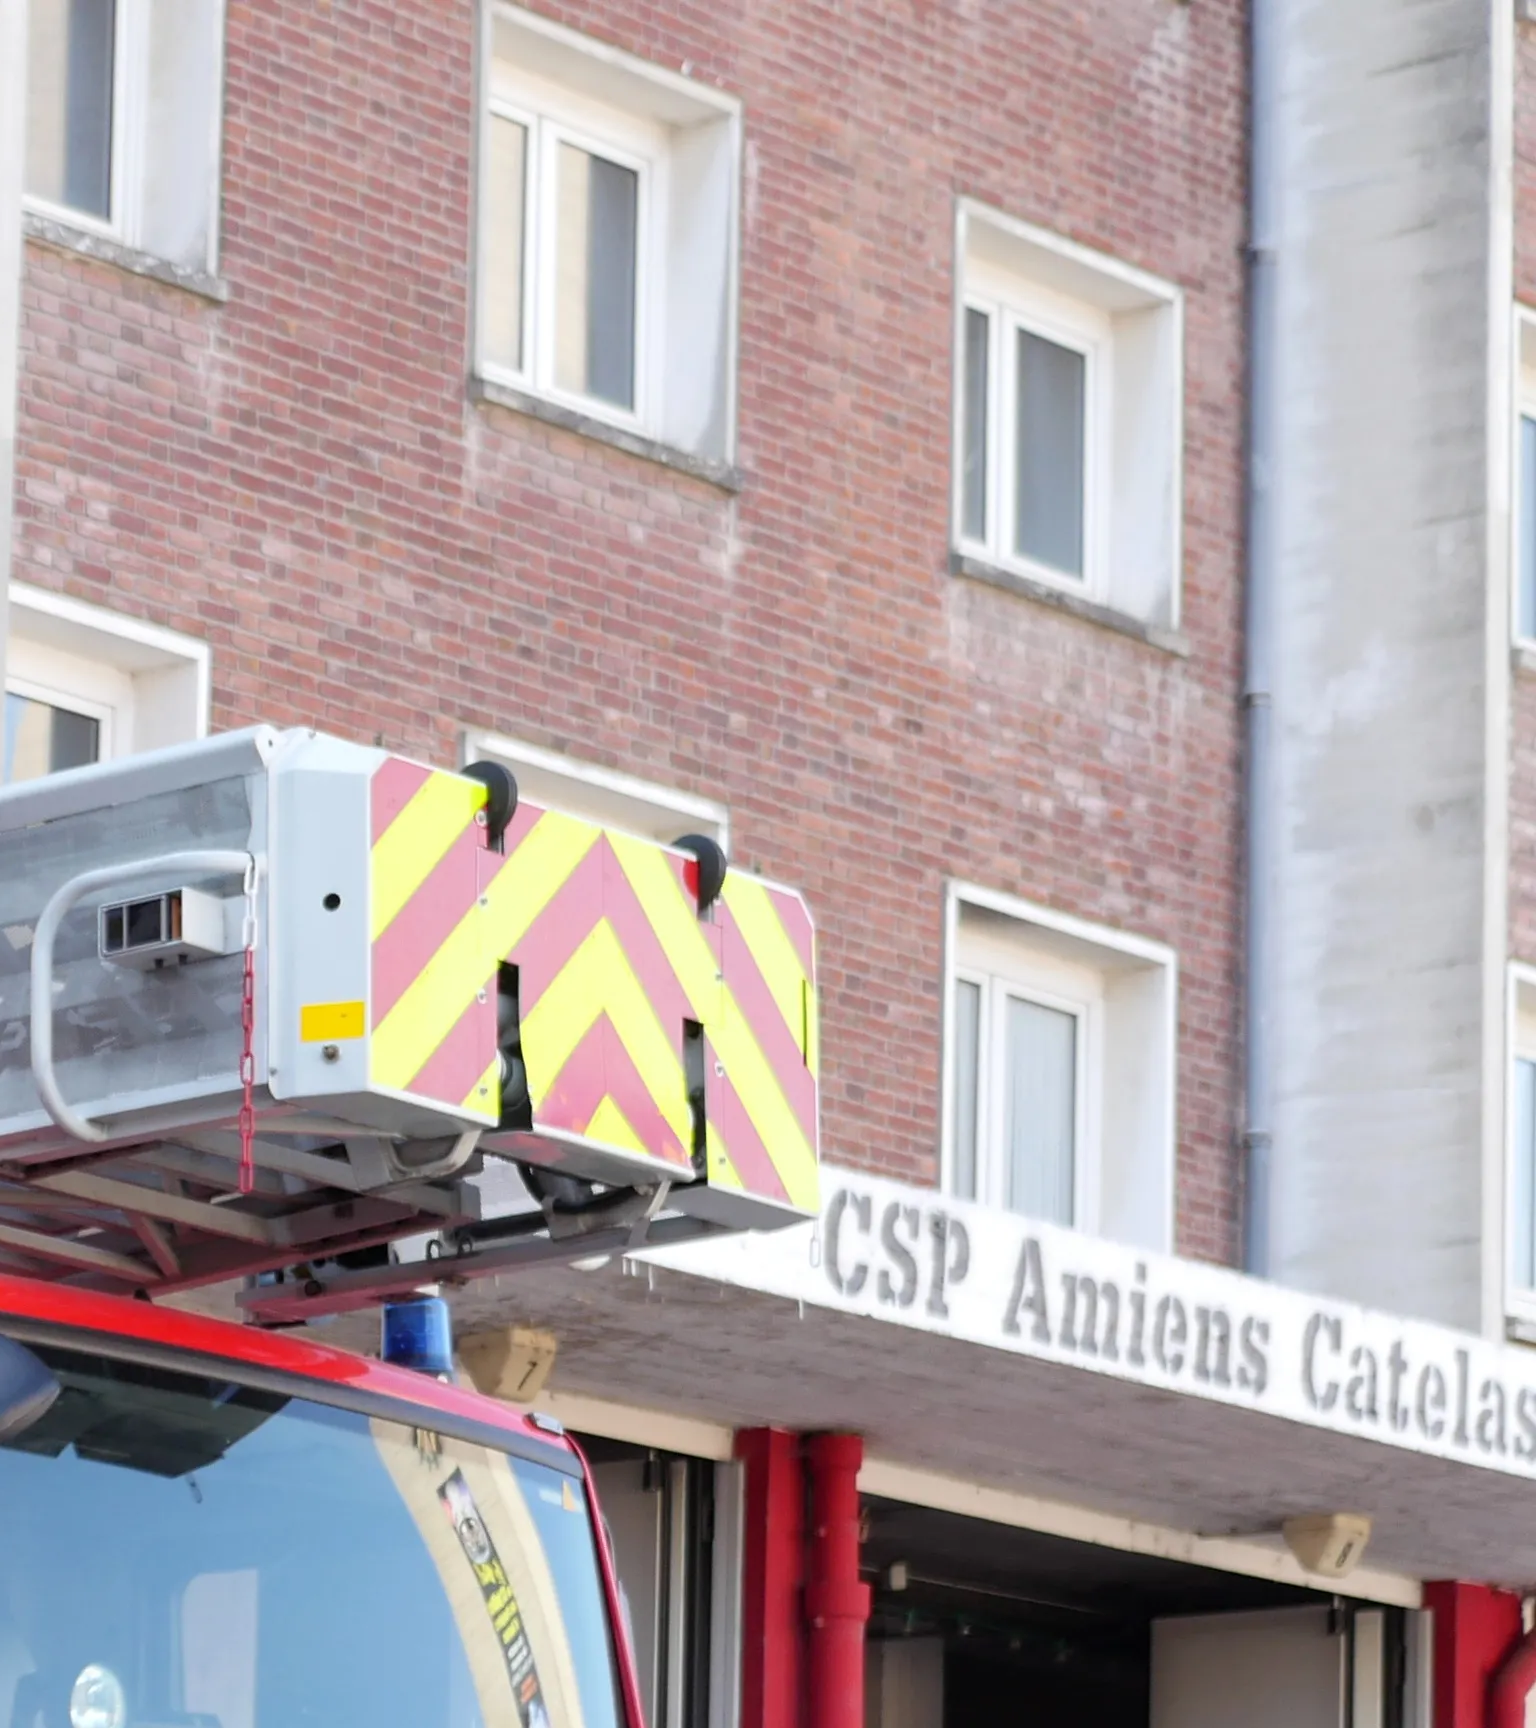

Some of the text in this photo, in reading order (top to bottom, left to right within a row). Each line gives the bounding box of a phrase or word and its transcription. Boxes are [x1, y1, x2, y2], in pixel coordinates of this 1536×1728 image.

[826, 1189, 970, 1318] CSP
[1003, 1236, 1270, 1397] Amiens
[517, 1360, 538, 1391] 7
